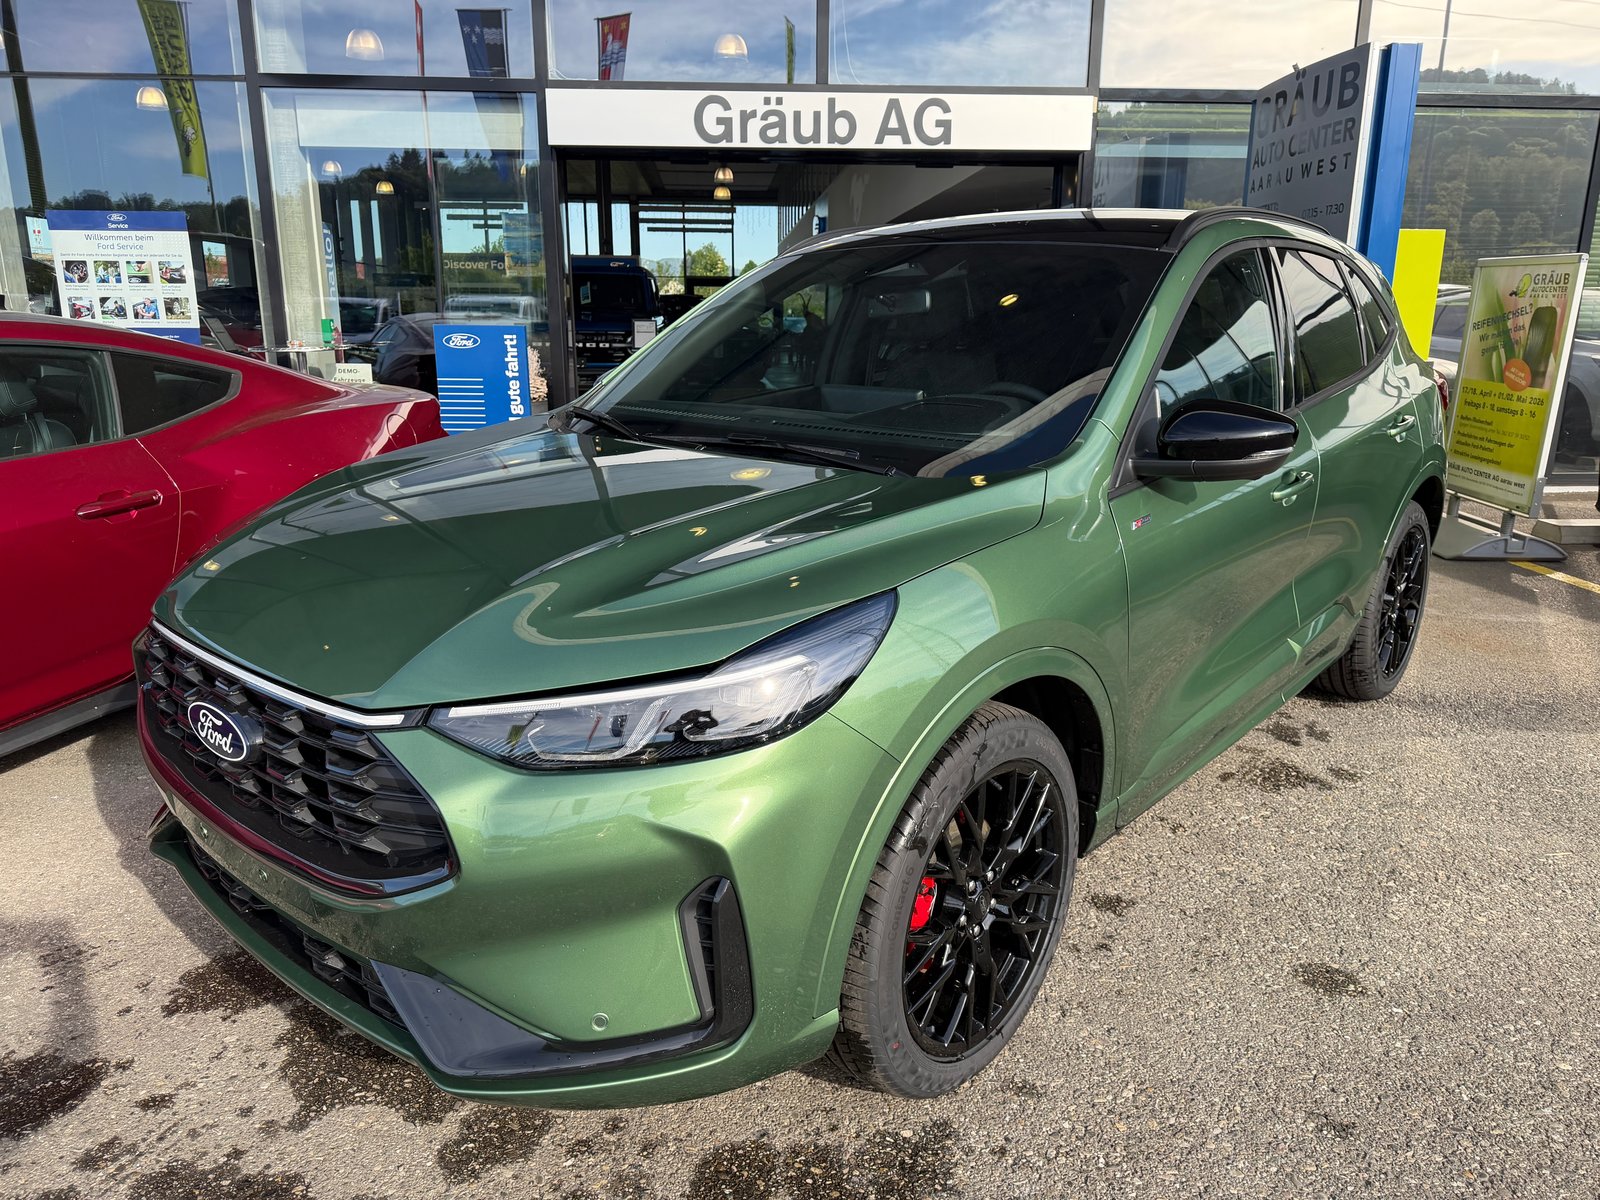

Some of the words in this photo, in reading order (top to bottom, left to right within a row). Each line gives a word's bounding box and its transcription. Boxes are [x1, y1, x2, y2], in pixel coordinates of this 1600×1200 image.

[1256, 61, 1360, 139] GRÄUB
[694, 94, 857, 145] Gräub
[874, 98, 952, 146] AG
[1252, 139, 1284, 170] AUTO
[1288, 117, 1356, 157] CENTER
[1250, 166, 1293, 194] AARAU
[1301, 152, 1351, 179] WEST
[84, 233, 133, 241] Willkommen
[1533, 270, 1570, 285] GRÄUB
[448, 334, 475, 347] Ford
[1479, 332, 1490, 343] Wir
[503, 335, 520, 378] fahrt!
[508, 380, 524, 415] gute
[1464, 399, 1482, 410] freitags
[1496, 406, 1519, 417] samstags
[1529, 410, 1537, 419] 16
[1479, 389, 1493, 399] April
[1516, 395, 1528, 404] Mai
[1529, 397, 1545, 406] 2026
[1461, 466, 1473, 475] AUTO
[1473, 469, 1491, 480] CENTER
[1492, 474, 1500, 482] AG
[197, 709, 233, 754] Ford
